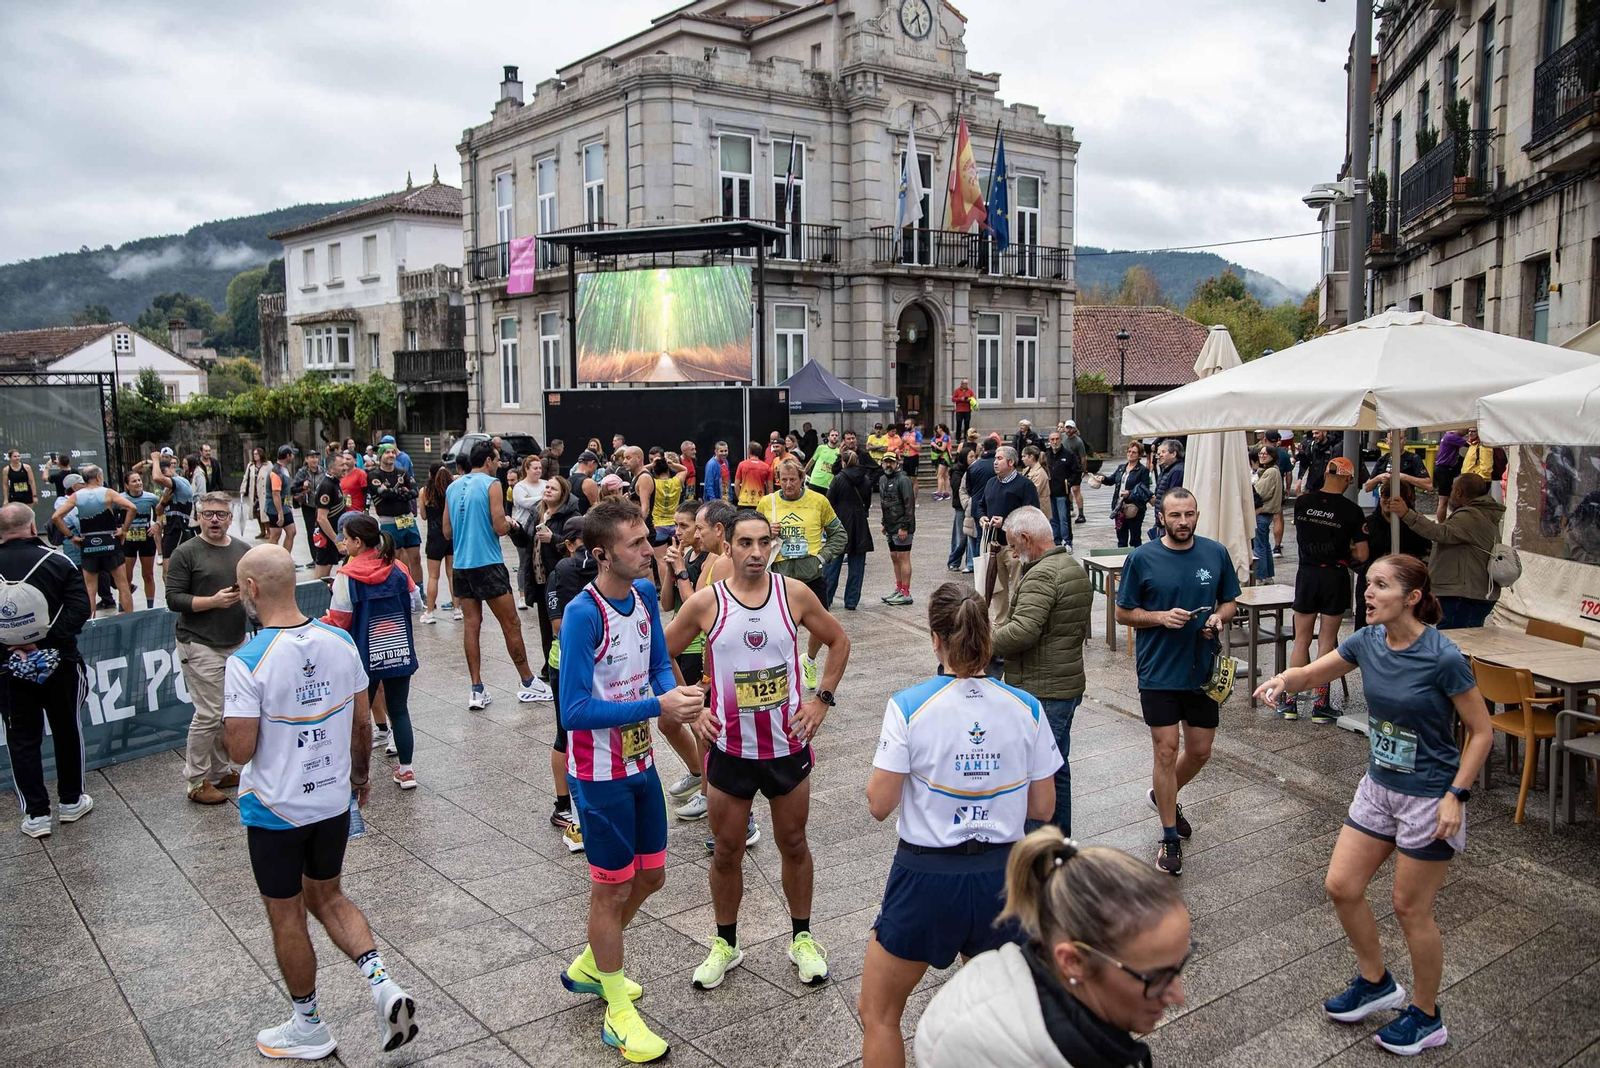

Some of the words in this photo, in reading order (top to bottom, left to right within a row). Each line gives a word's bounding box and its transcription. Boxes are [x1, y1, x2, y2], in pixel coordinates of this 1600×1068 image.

[11, 616, 36, 628] Serena
[295, 680, 330, 694] ATLETISMO
[1217, 669, 1229, 693] 466
[296, 687, 331, 702] SAMIL
[752, 682, 777, 698] 123
[1375, 733, 1397, 755] 731
[955, 760, 1000, 771] SAMIL
